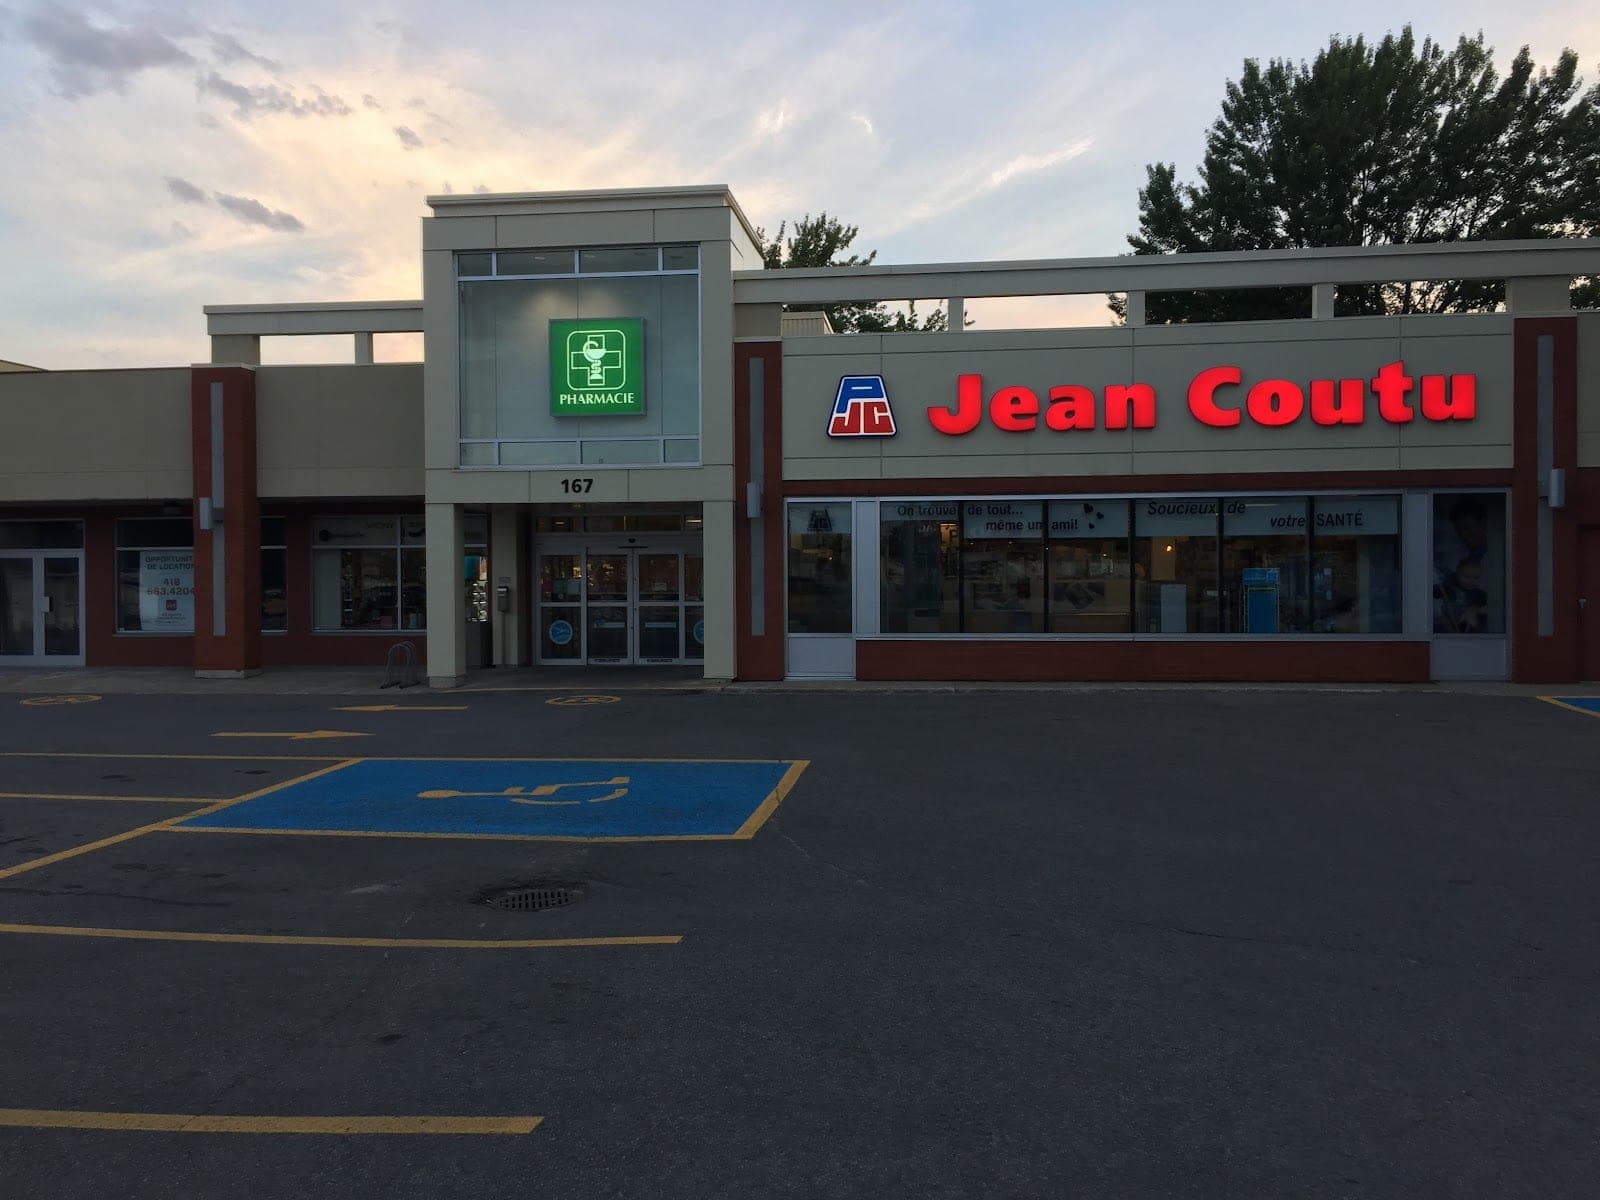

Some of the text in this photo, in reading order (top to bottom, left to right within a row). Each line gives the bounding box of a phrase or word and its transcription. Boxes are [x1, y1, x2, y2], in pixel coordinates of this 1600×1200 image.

[559, 392, 635, 405] PHARMACIE
[927, 360, 1477, 436] Jean Coutu
[561, 478, 594, 493] 167
[897, 504, 1024, 517] On trouve de tout...
[1147, 501, 1246, 515] Soucieux de
[985, 518, 1079, 531] même un ami!
[1270, 509, 1363, 528] votre SANTÉ
